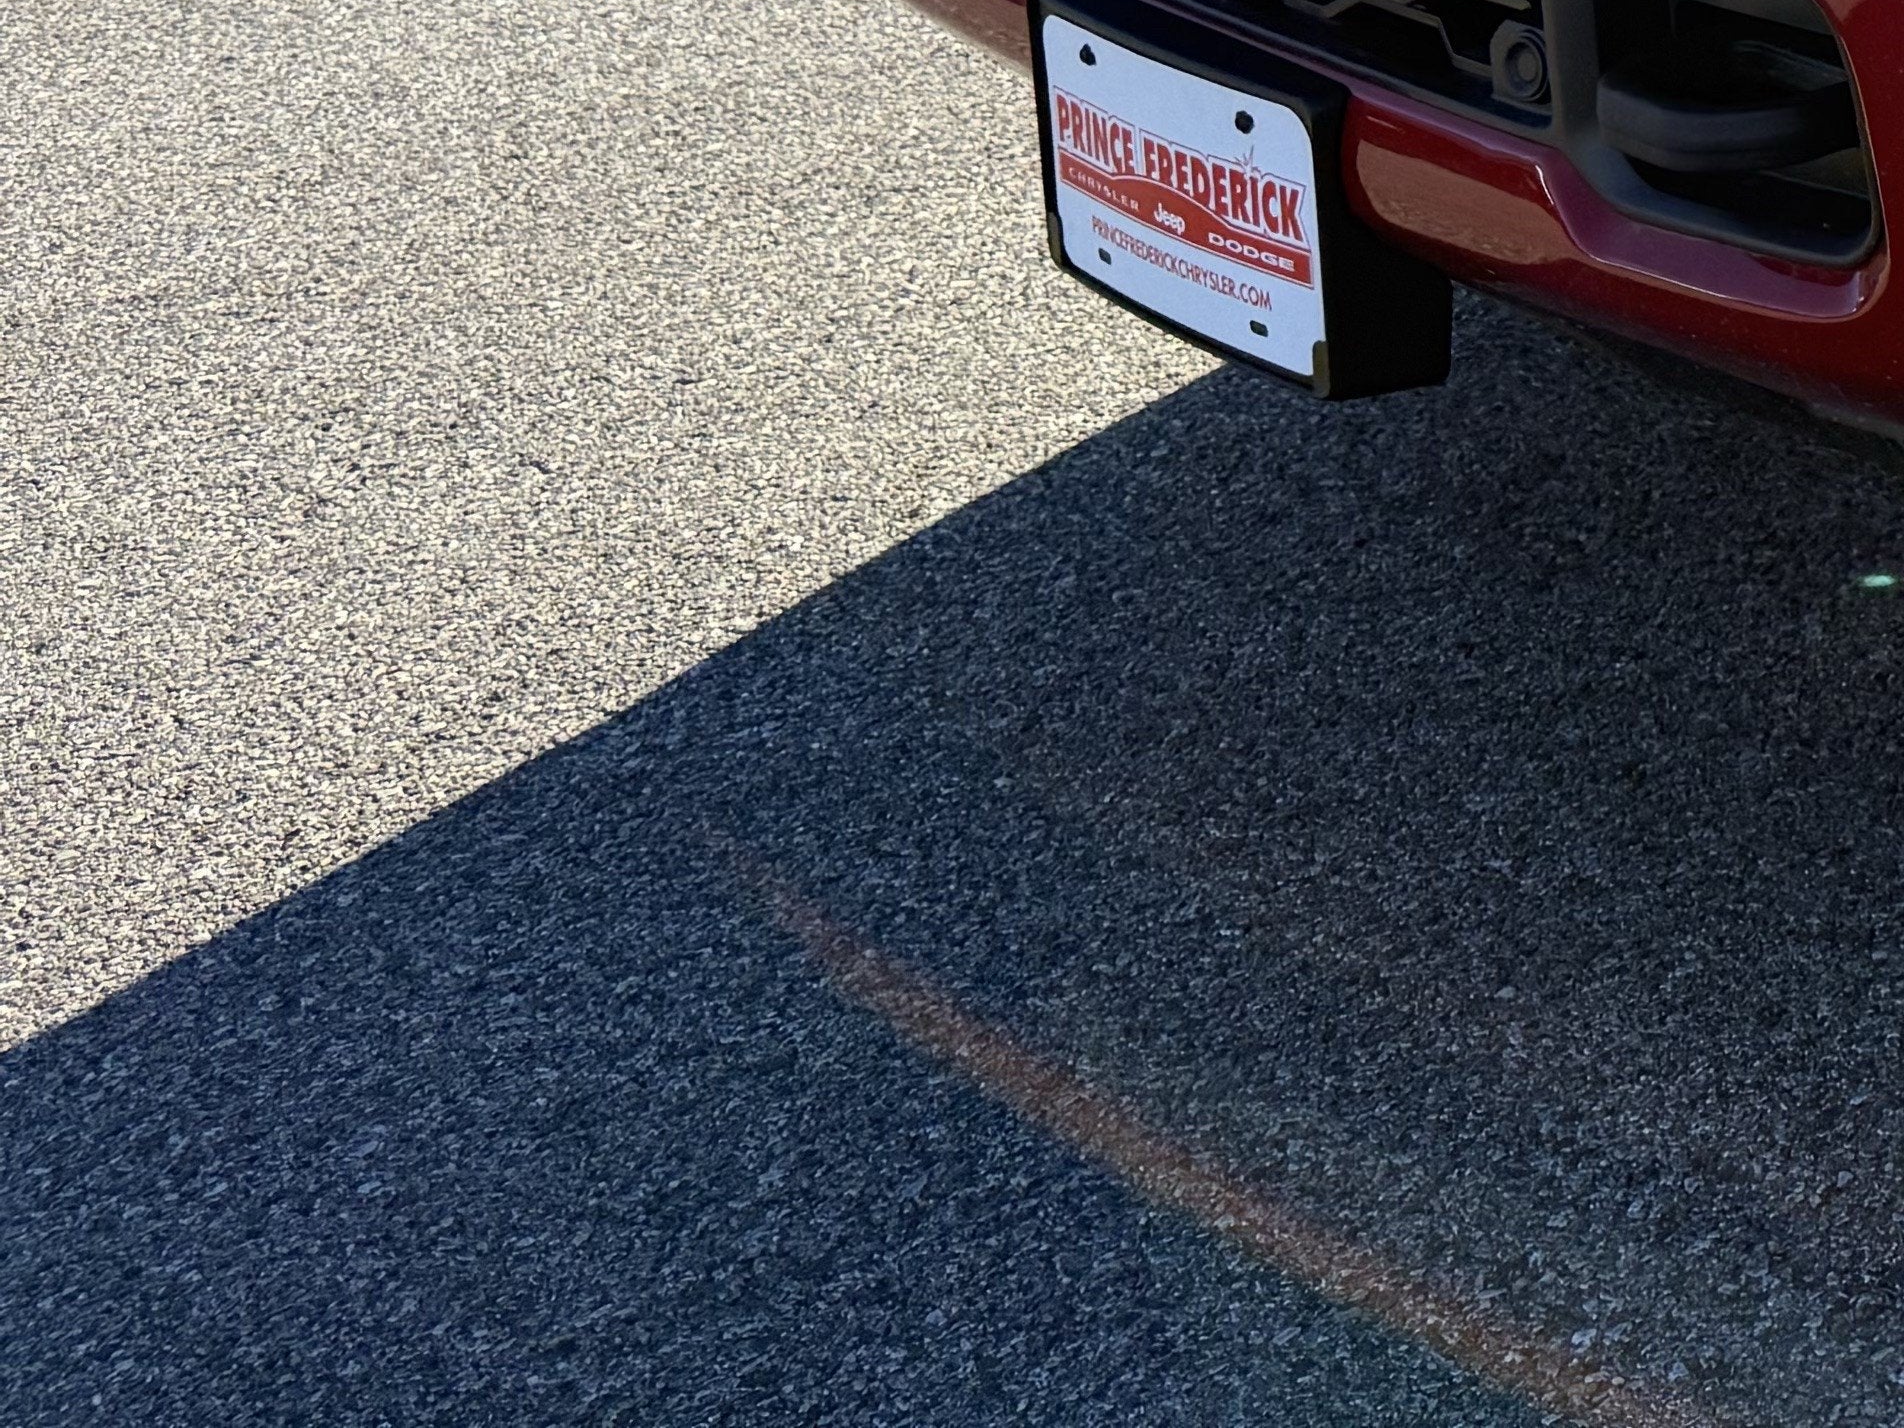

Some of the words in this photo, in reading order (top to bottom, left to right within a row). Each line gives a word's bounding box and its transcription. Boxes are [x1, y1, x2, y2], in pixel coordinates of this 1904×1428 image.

[1056, 93, 1136, 176] PRINCE
[1142, 135, 1304, 242] FREDERICK
[1067, 166, 1140, 212] CHRYSLER
[1153, 201, 1186, 236] Jeep
[1207, 232, 1295, 272] DODGE
[1091, 214, 1273, 311] PRINCEFREDERICKCHRYSLER.COM
